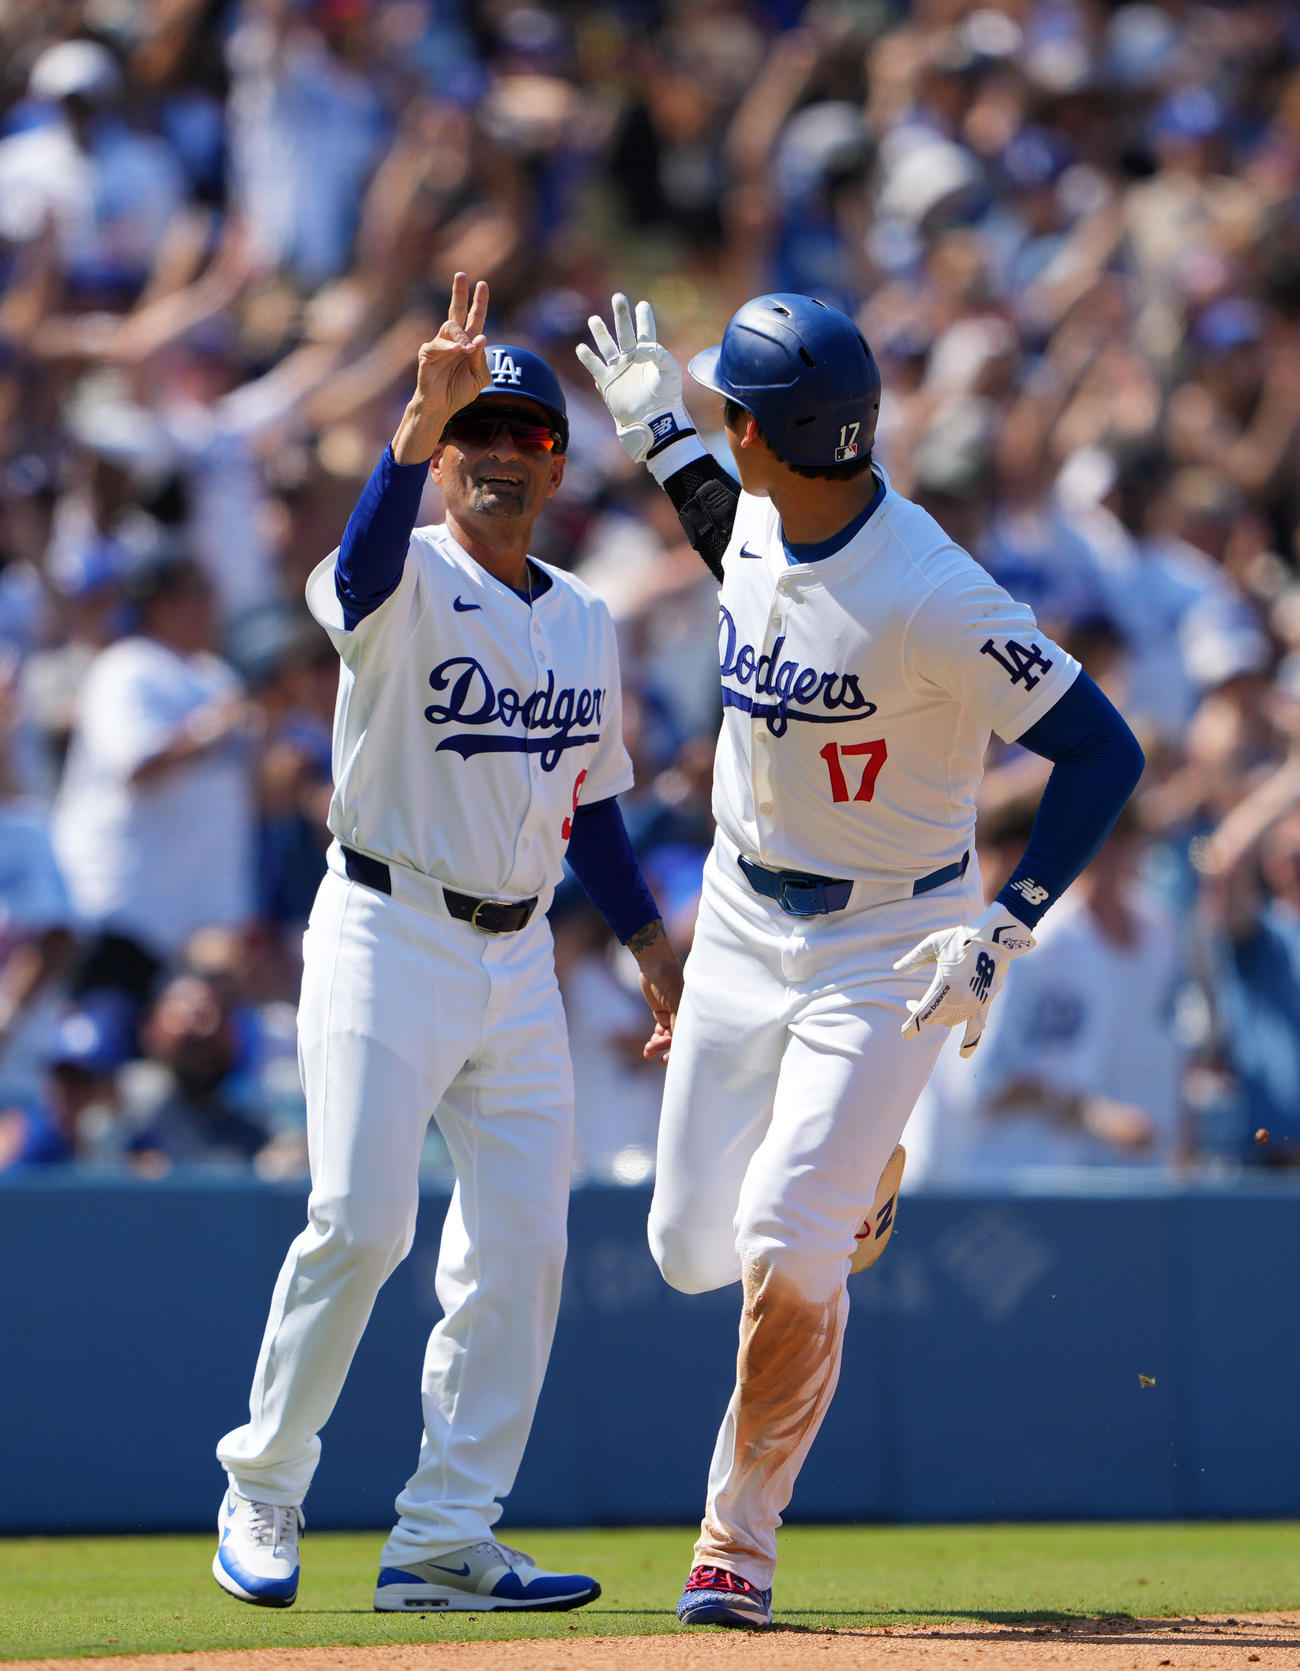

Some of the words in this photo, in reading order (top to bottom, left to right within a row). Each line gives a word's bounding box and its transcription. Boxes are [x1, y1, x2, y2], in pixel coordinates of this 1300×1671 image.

[490, 349, 522, 385] LA
[839, 421, 861, 447] 17
[980, 639, 1053, 692] LA
[424, 656, 606, 772] Dodger
[819, 738, 888, 803] 17
[921, 1009, 932, 1022] new
[931, 985, 950, 1011] balance
